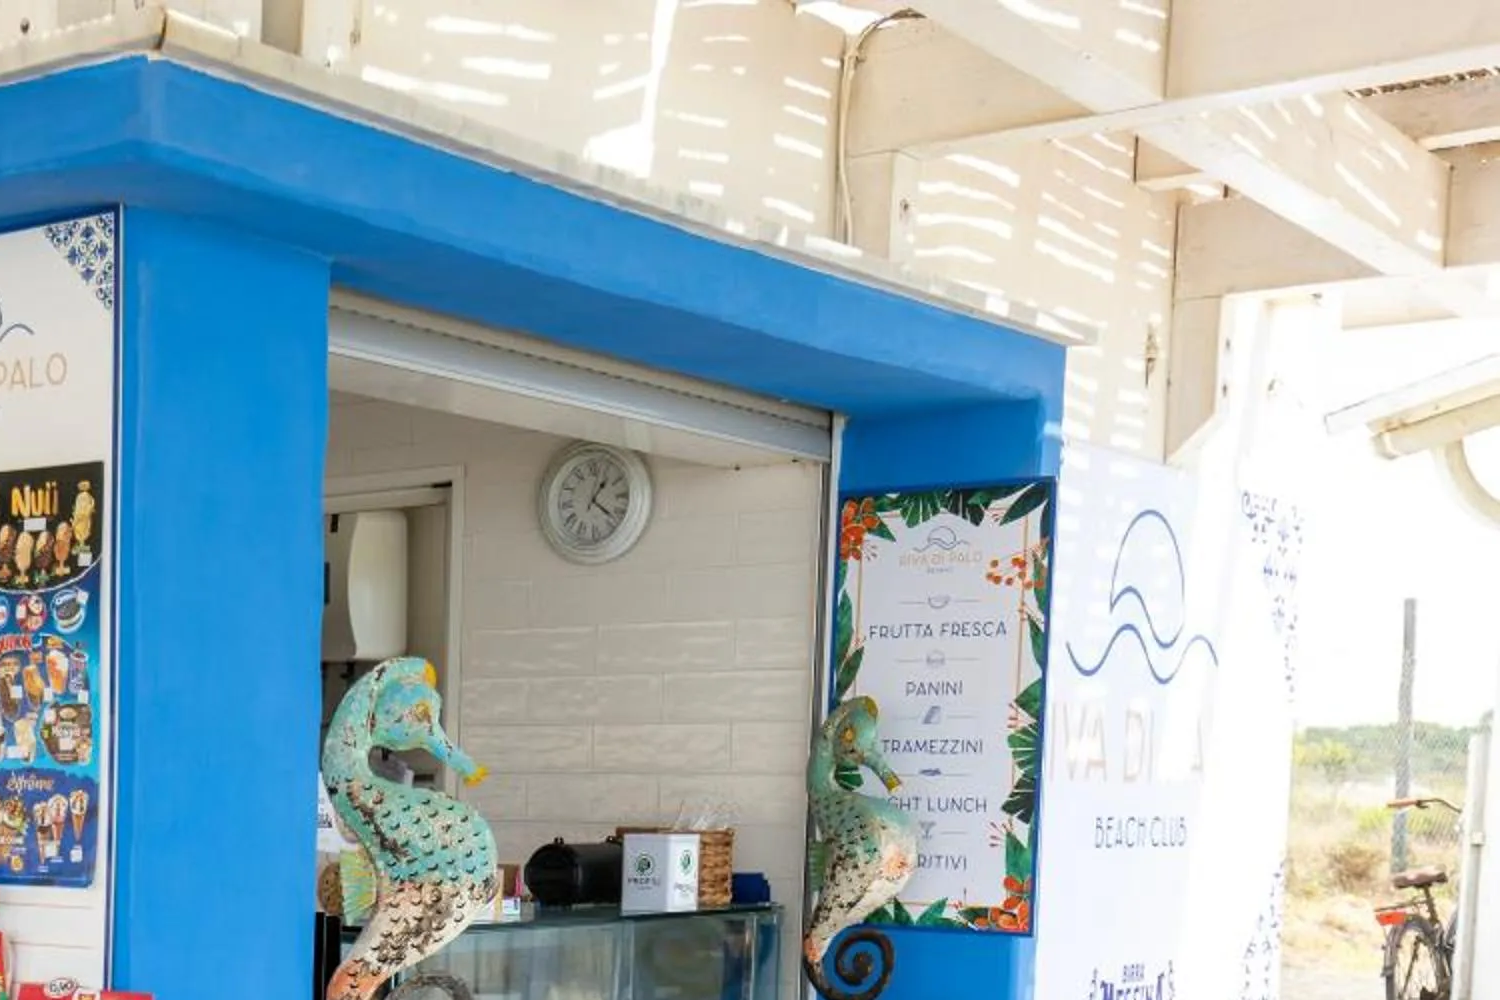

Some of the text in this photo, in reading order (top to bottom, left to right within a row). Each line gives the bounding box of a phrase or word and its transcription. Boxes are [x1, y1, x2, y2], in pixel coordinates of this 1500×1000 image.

[869, 620, 1008, 640] FRUTTA FRESCA
[905, 679, 964, 697] PANINI
[881, 738, 984, 756] TRAMEZZINI
[1050, 701, 1108, 783] IVA
[927, 797, 988, 813] LUNCH
[1094, 815, 1188, 850] BEACH CLUB
[916, 854, 968, 871] RITIVI
